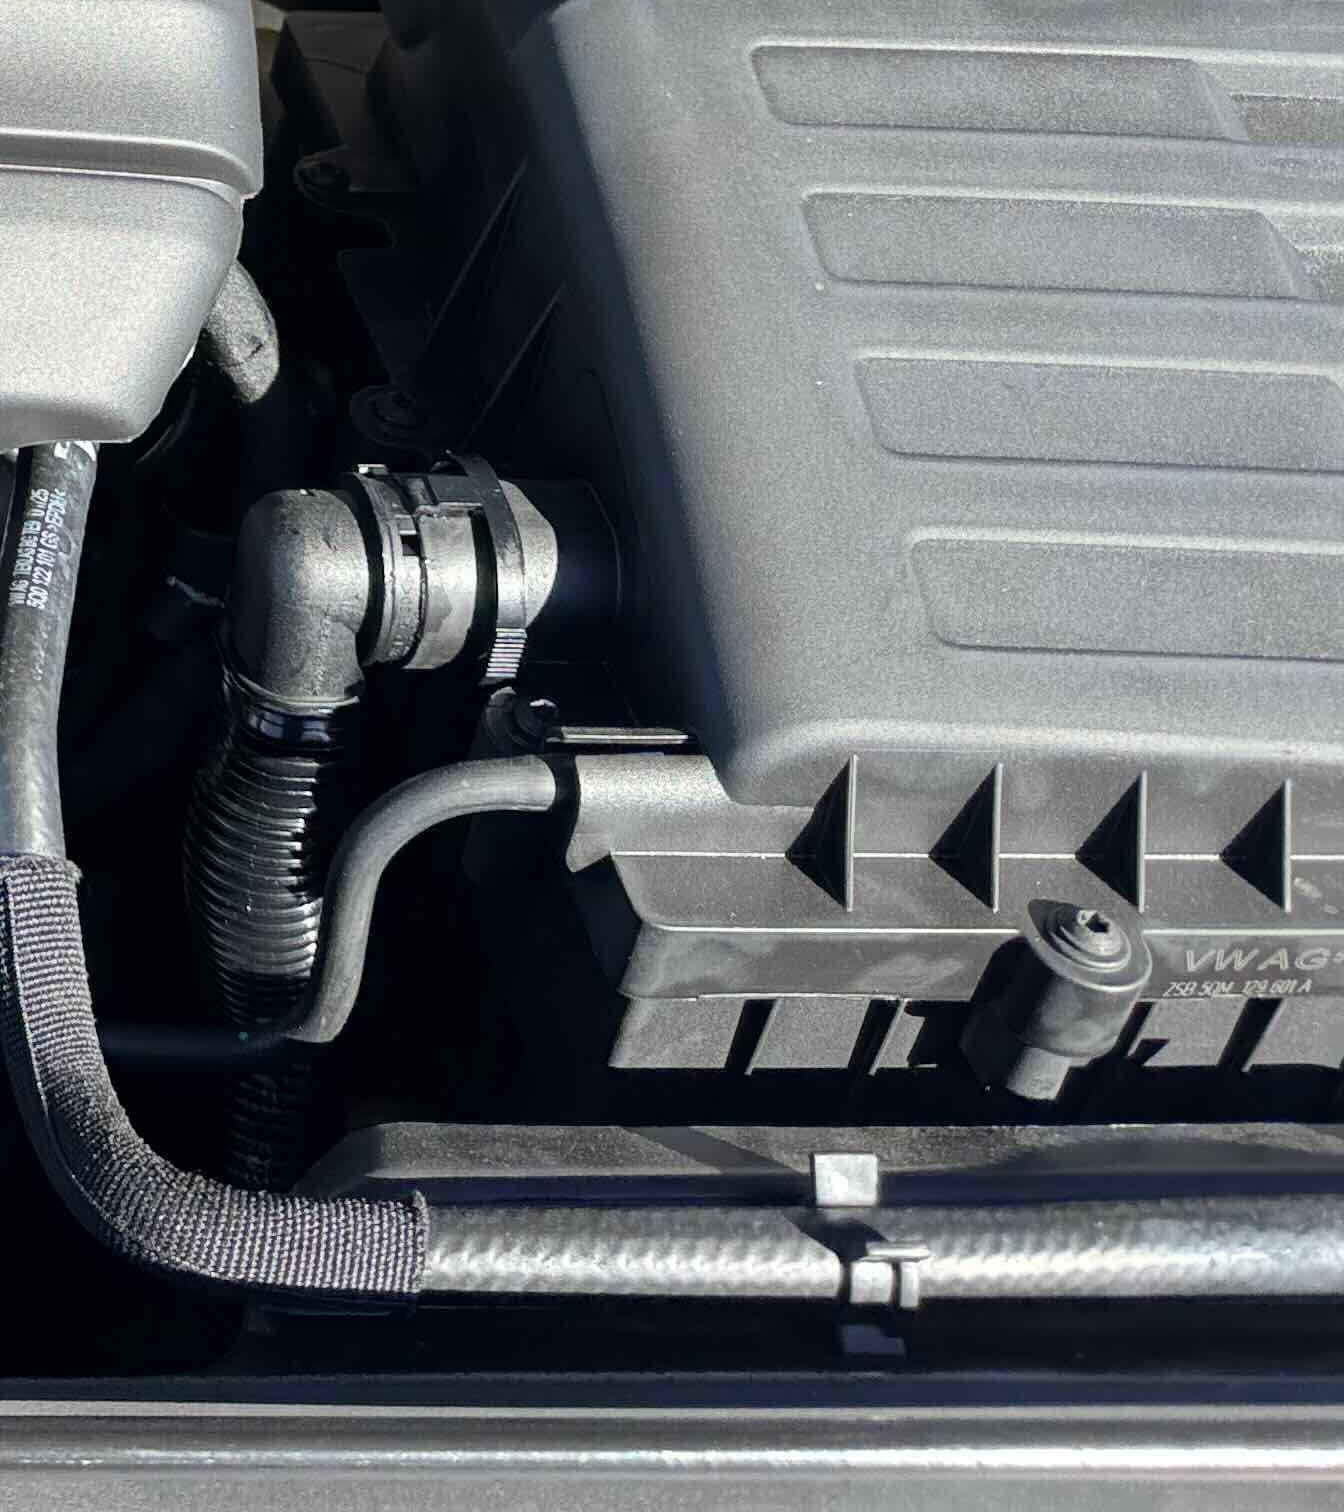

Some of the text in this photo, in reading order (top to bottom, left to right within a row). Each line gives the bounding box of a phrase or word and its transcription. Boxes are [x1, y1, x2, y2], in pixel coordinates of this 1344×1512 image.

[35, 548, 56, 567] 101
[31, 565, 52, 586] 122
[1186, 948, 1332, 972] VW AG
[1298, 978, 1313, 993] A
